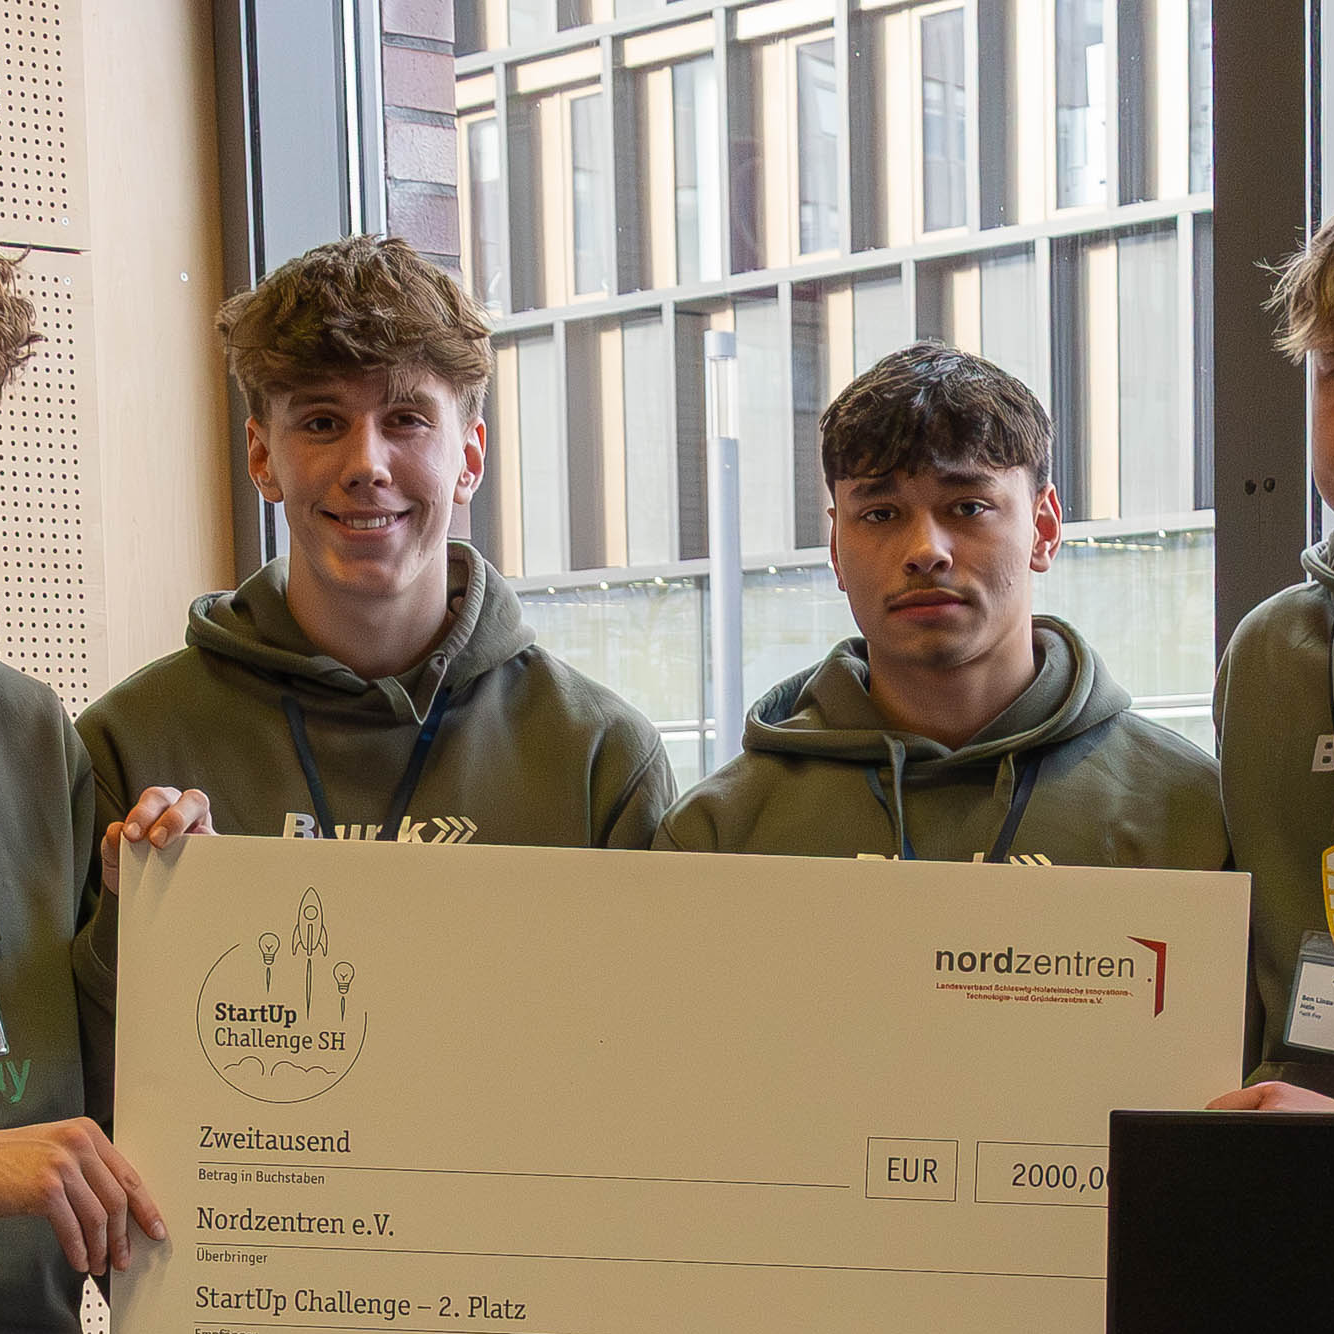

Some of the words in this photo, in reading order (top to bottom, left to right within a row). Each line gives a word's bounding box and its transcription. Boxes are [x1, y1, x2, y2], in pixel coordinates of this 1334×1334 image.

[935, 947, 1134, 978] nordzentren
[214, 1001, 297, 1028] StartUp
[214, 1027, 313, 1054] Challenge
[319, 1032, 346, 1051] SH
[199, 1125, 351, 1154] Zweitausend
[198, 1168, 238, 1186] Betrag
[241, 1170, 252, 1184] in
[255, 1170, 326, 1185] Buchstaben
[888, 1157, 938, 1184] EUR
[1012, 1163, 1109, 1193] 2000,0
[196, 1207, 345, 1236] Nordzentren
[352, 1212, 395, 1238] e.V.
[196, 1248, 267, 1266] Überbringer
[195, 1286, 287, 1314] StartUp
[294, 1288, 411, 1321] Challenge
[438, 1296, 460, 1318] 2.
[468, 1297, 526, 1321] Platz
